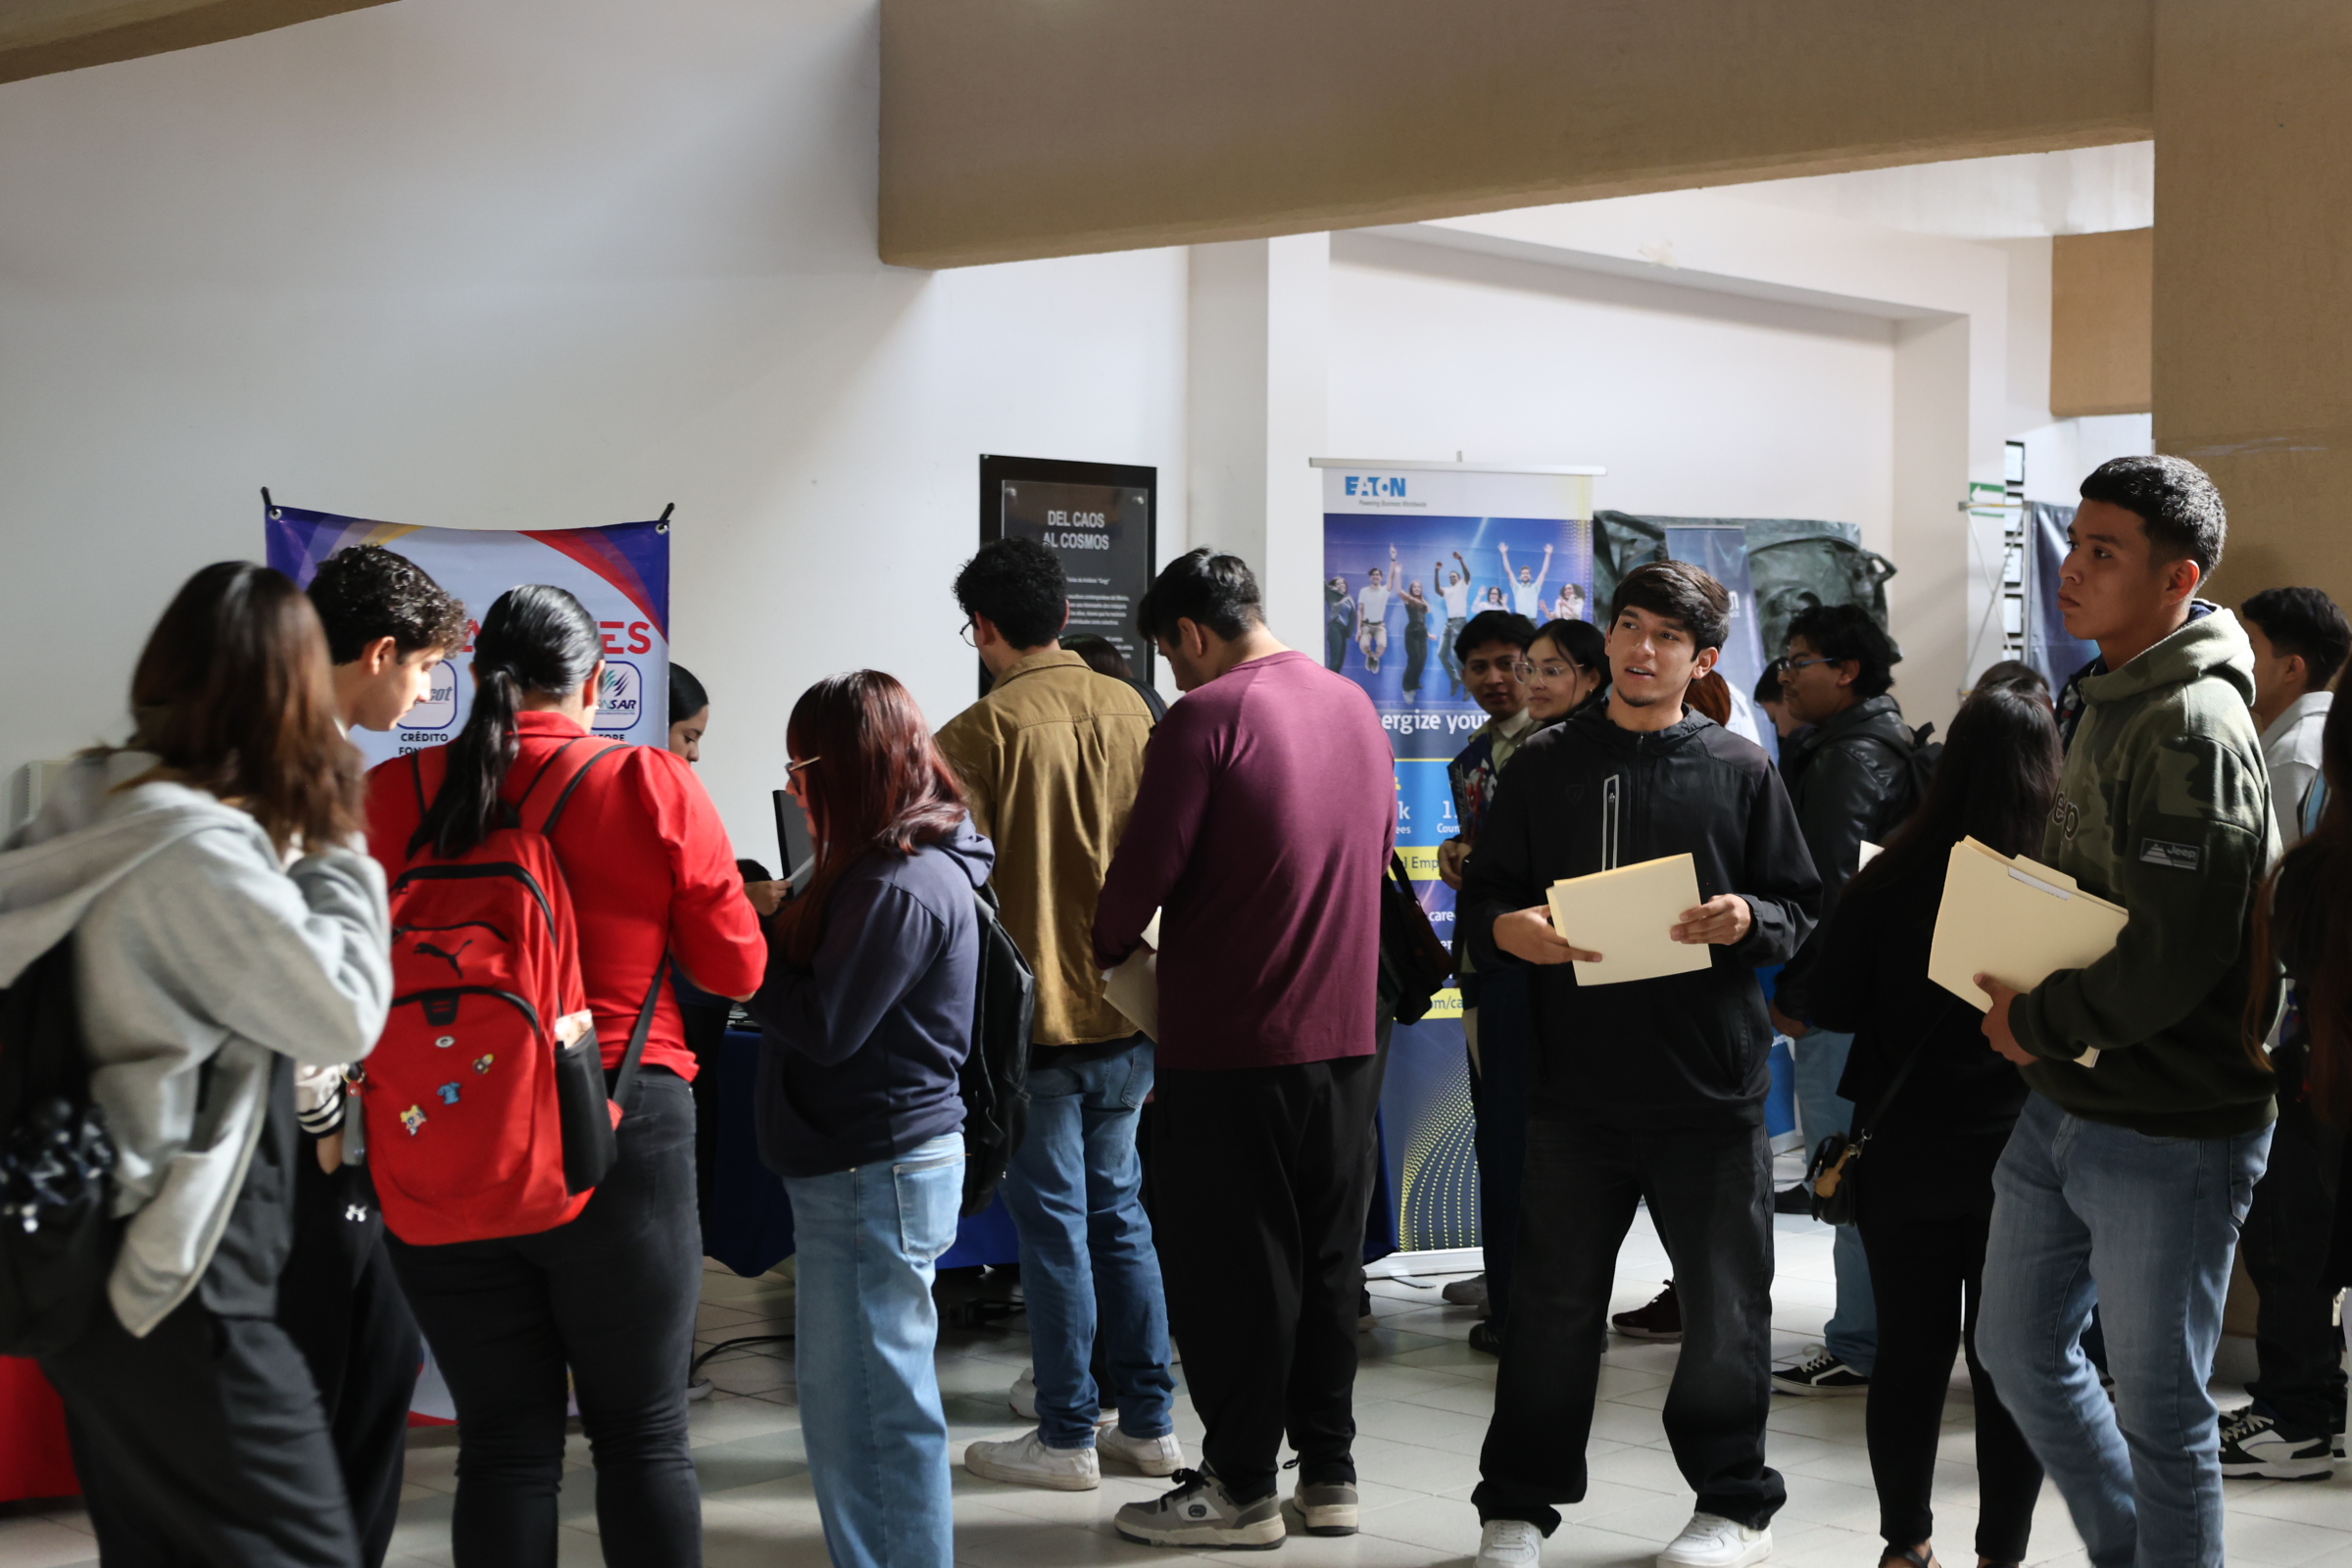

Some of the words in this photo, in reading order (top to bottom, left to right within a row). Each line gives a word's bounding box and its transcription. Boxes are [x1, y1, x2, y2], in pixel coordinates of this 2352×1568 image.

[1345, 475, 1406, 497] EATON
[1048, 510, 1071, 526] DEL
[1072, 511, 1105, 528] CAOS
[1043, 532, 1058, 548] AL
[1059, 532, 1109, 550] COSMOS
[594, 620, 652, 655] ES
[429, 686, 453, 702] cot
[598, 699, 637, 710] NSAR
[1381, 709, 1442, 734] ergize
[401, 731, 449, 742] CRÉDITO
[1396, 800, 1411, 819] k
[1396, 826, 1411, 835] ees
[1437, 822, 1461, 834] Coun
[1411, 856, 1440, 872] Emp
[1428, 910, 1456, 922] care
